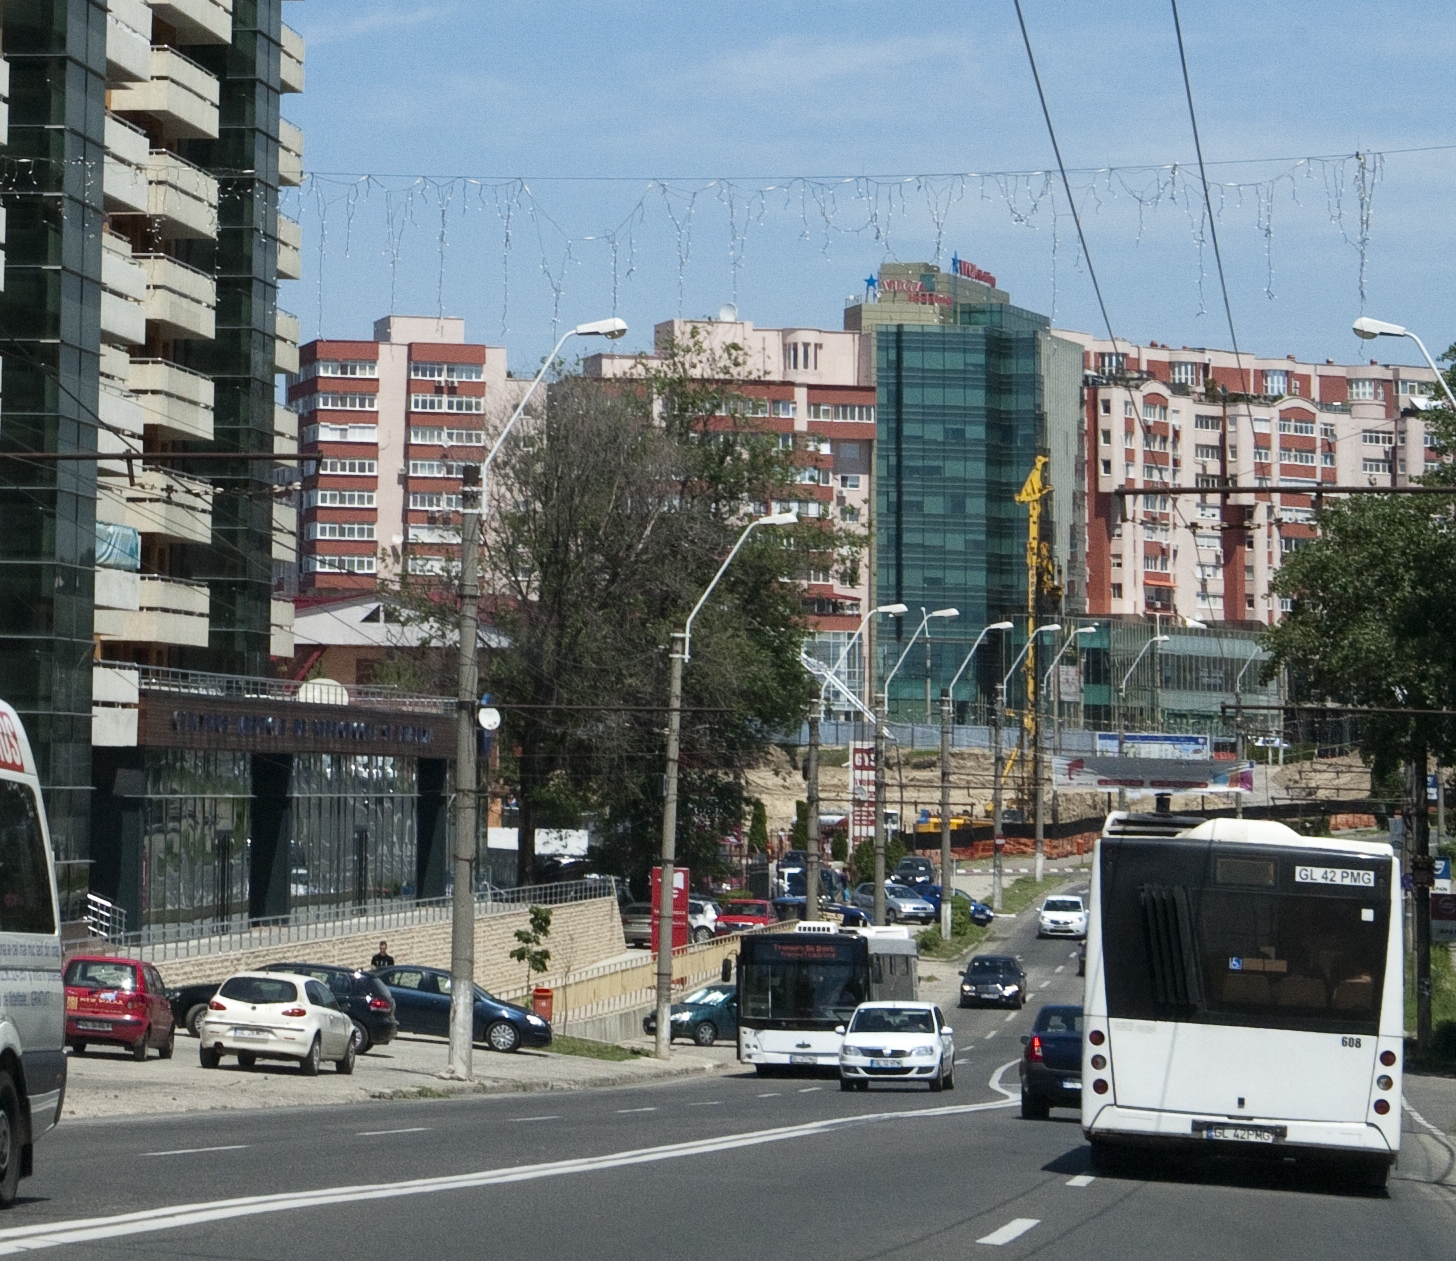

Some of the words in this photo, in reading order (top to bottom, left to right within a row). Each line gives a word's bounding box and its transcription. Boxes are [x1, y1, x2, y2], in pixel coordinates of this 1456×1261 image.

[1298, 868, 1318, 881] GL
[1321, 869, 1337, 883] 42
[1340, 870, 1372, 885] PMG
[1341, 1036, 1362, 1049] 608
